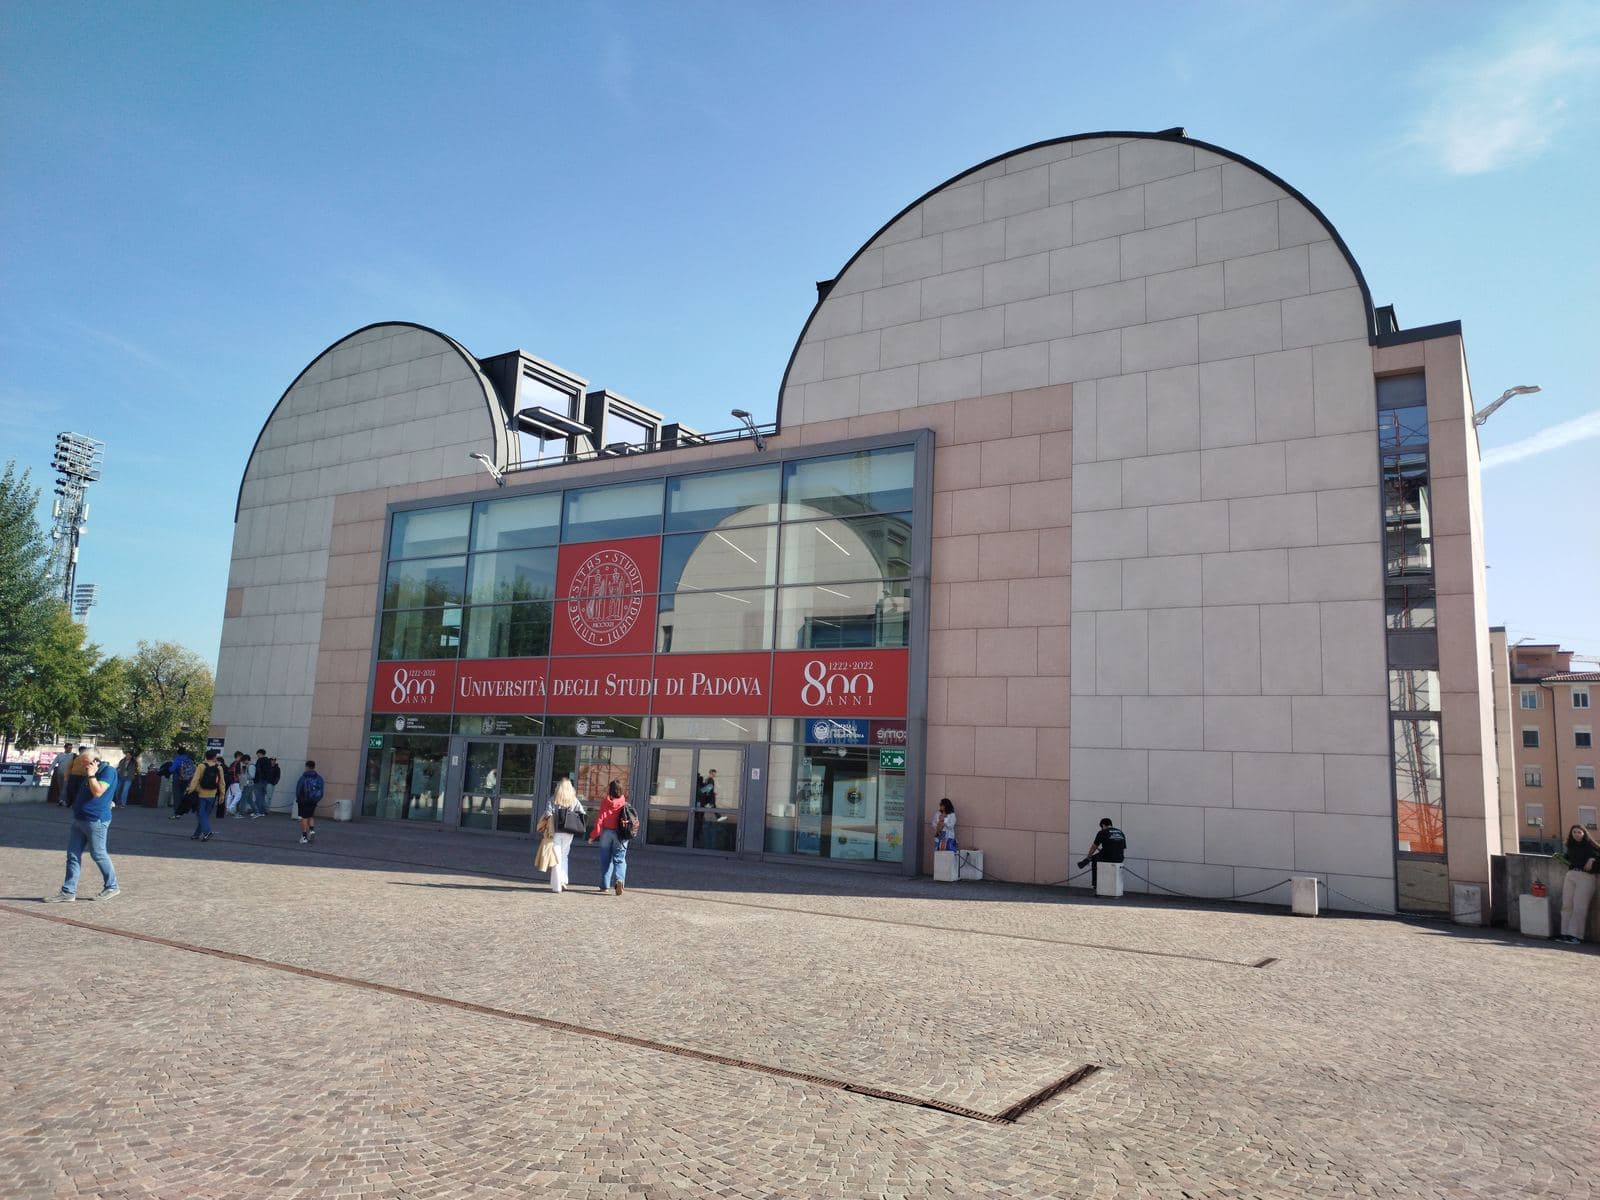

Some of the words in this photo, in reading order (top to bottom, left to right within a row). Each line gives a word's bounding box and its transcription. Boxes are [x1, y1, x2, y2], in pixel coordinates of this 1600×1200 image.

[553, 678, 599, 696] DEGLI
[605, 673, 659, 696] STUDI
[666, 678, 684, 696] DI
[691, 672, 762, 696] PADOVA
[826, 695, 873, 706] ANNI
